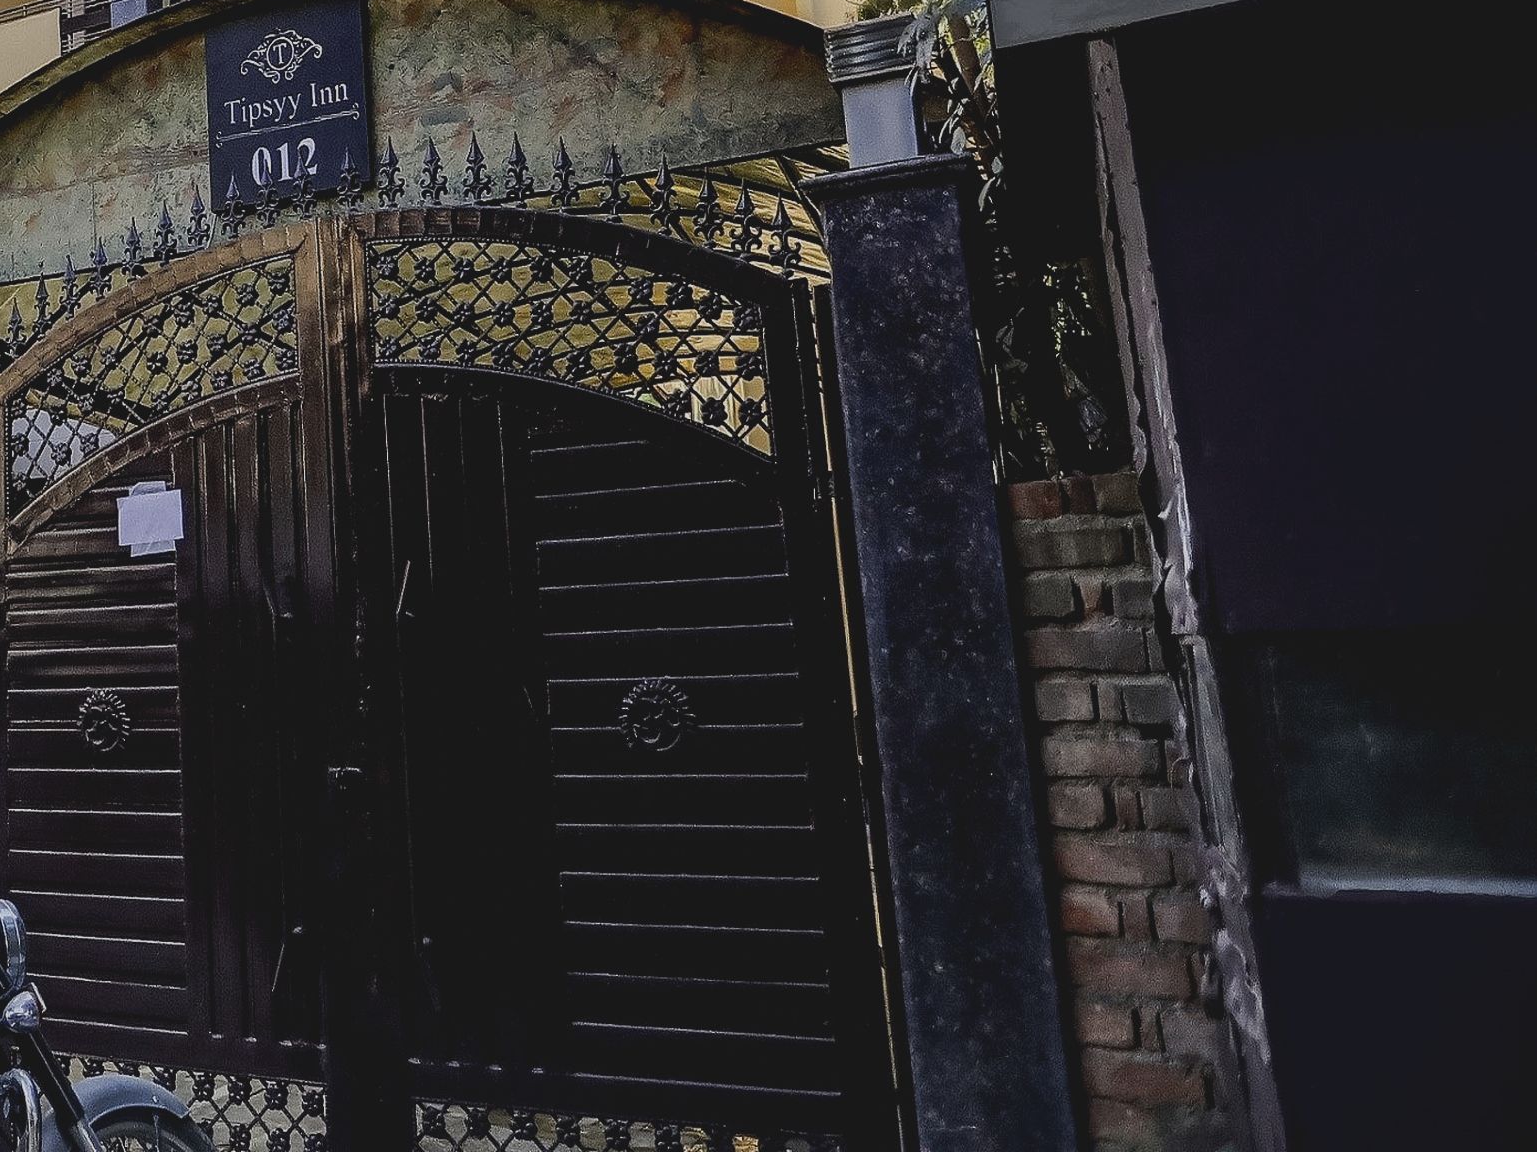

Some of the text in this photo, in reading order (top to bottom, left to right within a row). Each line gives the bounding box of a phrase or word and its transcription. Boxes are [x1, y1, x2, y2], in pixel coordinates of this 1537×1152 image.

[272, 42, 288, 65] T
[224, 82, 349, 127] Tipsyy Inn
[250, 137, 319, 187] 012
